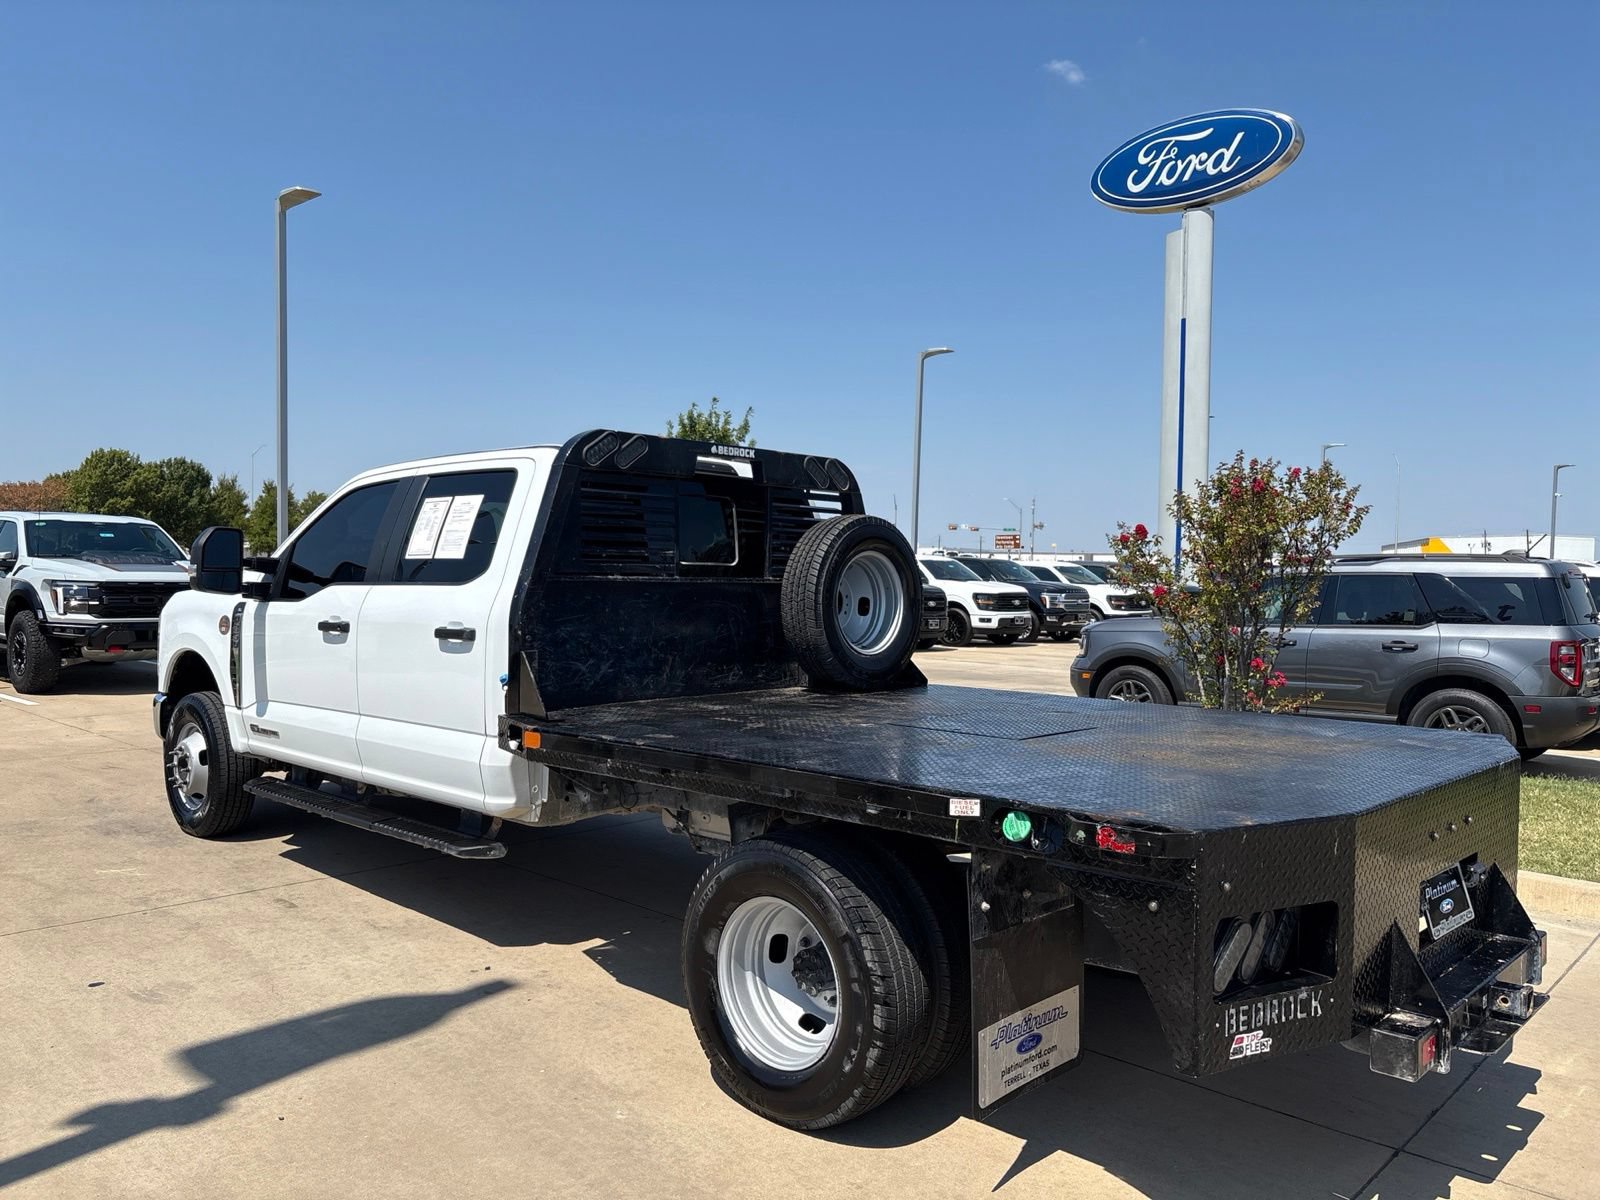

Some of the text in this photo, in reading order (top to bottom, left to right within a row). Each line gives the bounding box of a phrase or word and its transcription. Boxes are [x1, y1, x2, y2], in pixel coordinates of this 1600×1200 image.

[1126, 127, 1245, 193] Ford
[717, 445, 756, 459] BEDROCK
[1425, 879, 1461, 901] Platinum
[990, 1005, 1068, 1050] Platinum
[1225, 989, 1323, 1038] BEDROCK
[1001, 1044, 1058, 1080] platinumford.com
[1032, 1059, 1050, 1074] TEXAS
